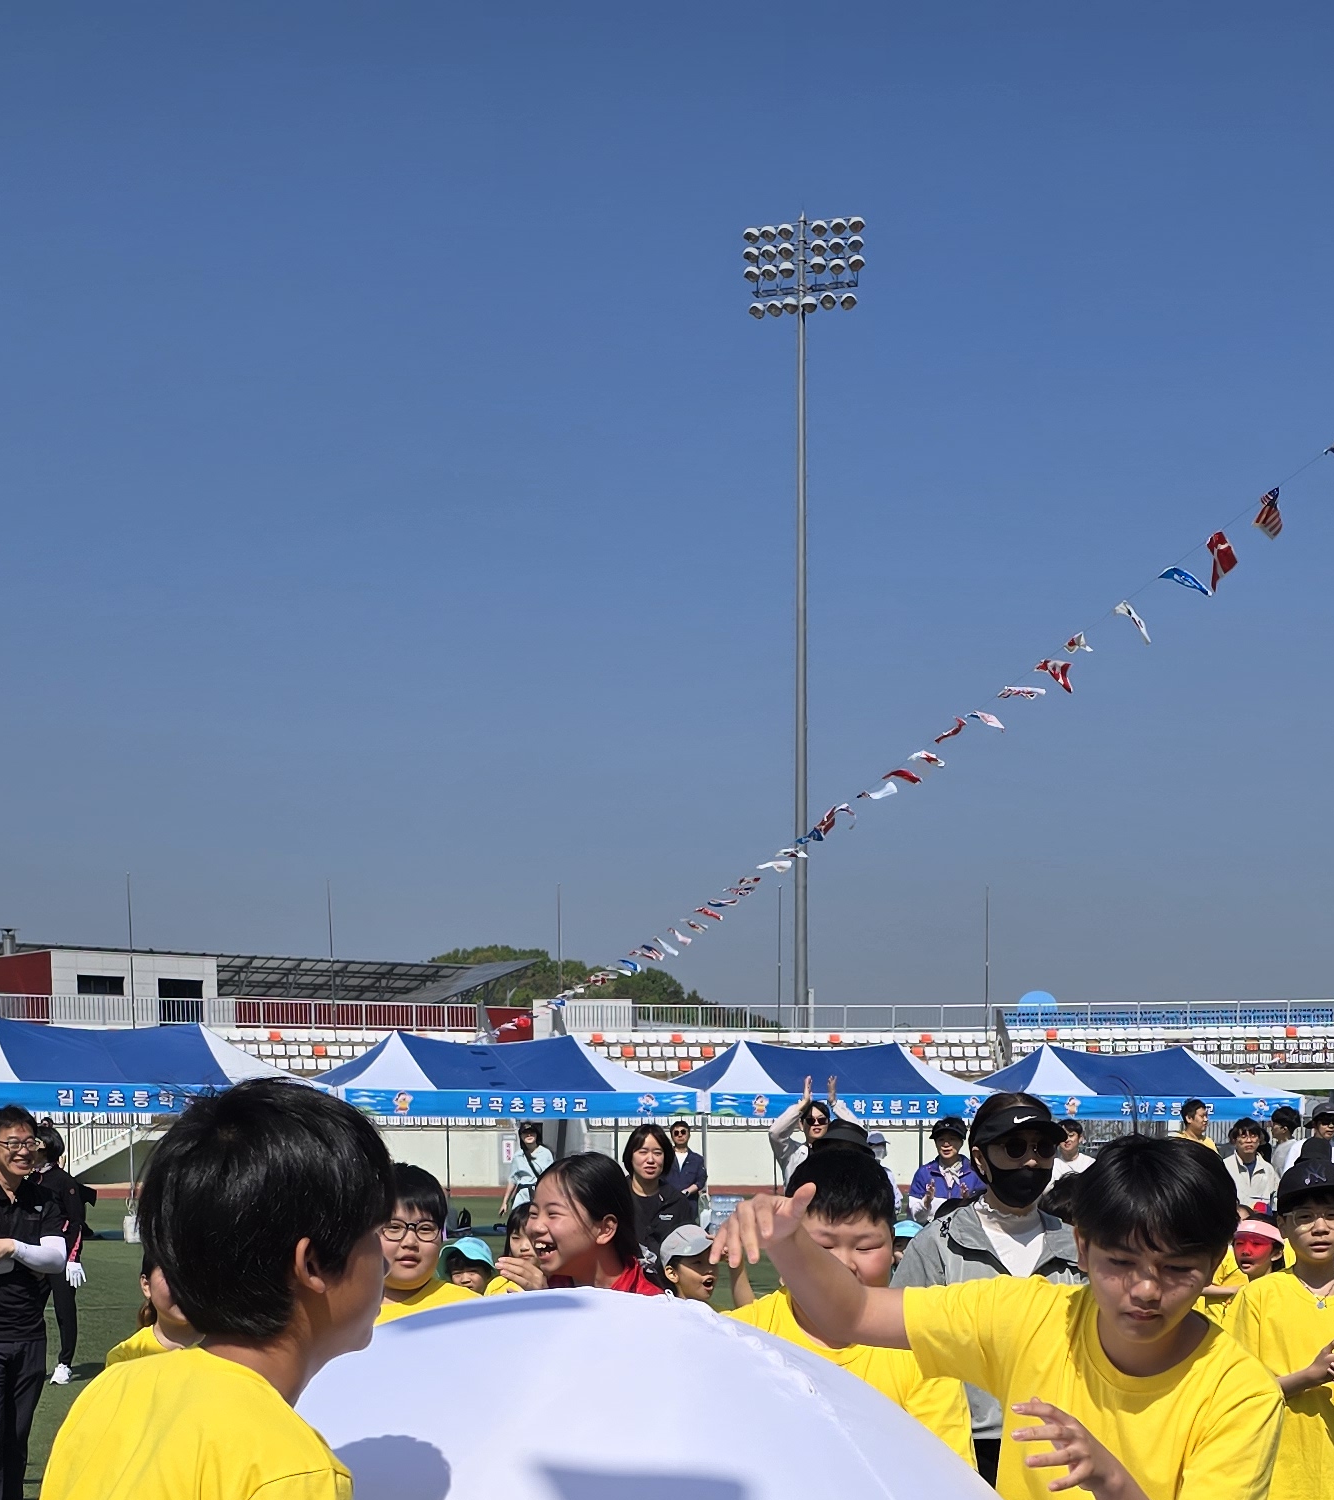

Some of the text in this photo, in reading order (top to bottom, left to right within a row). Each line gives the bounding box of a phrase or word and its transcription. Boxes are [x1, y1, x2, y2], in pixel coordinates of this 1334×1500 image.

[56, 1089, 195, 1109] 길곡초등학
[466, 1096, 589, 1114] 부곡초등학교
[1120, 1101, 1215, 1116] 유어초등교
